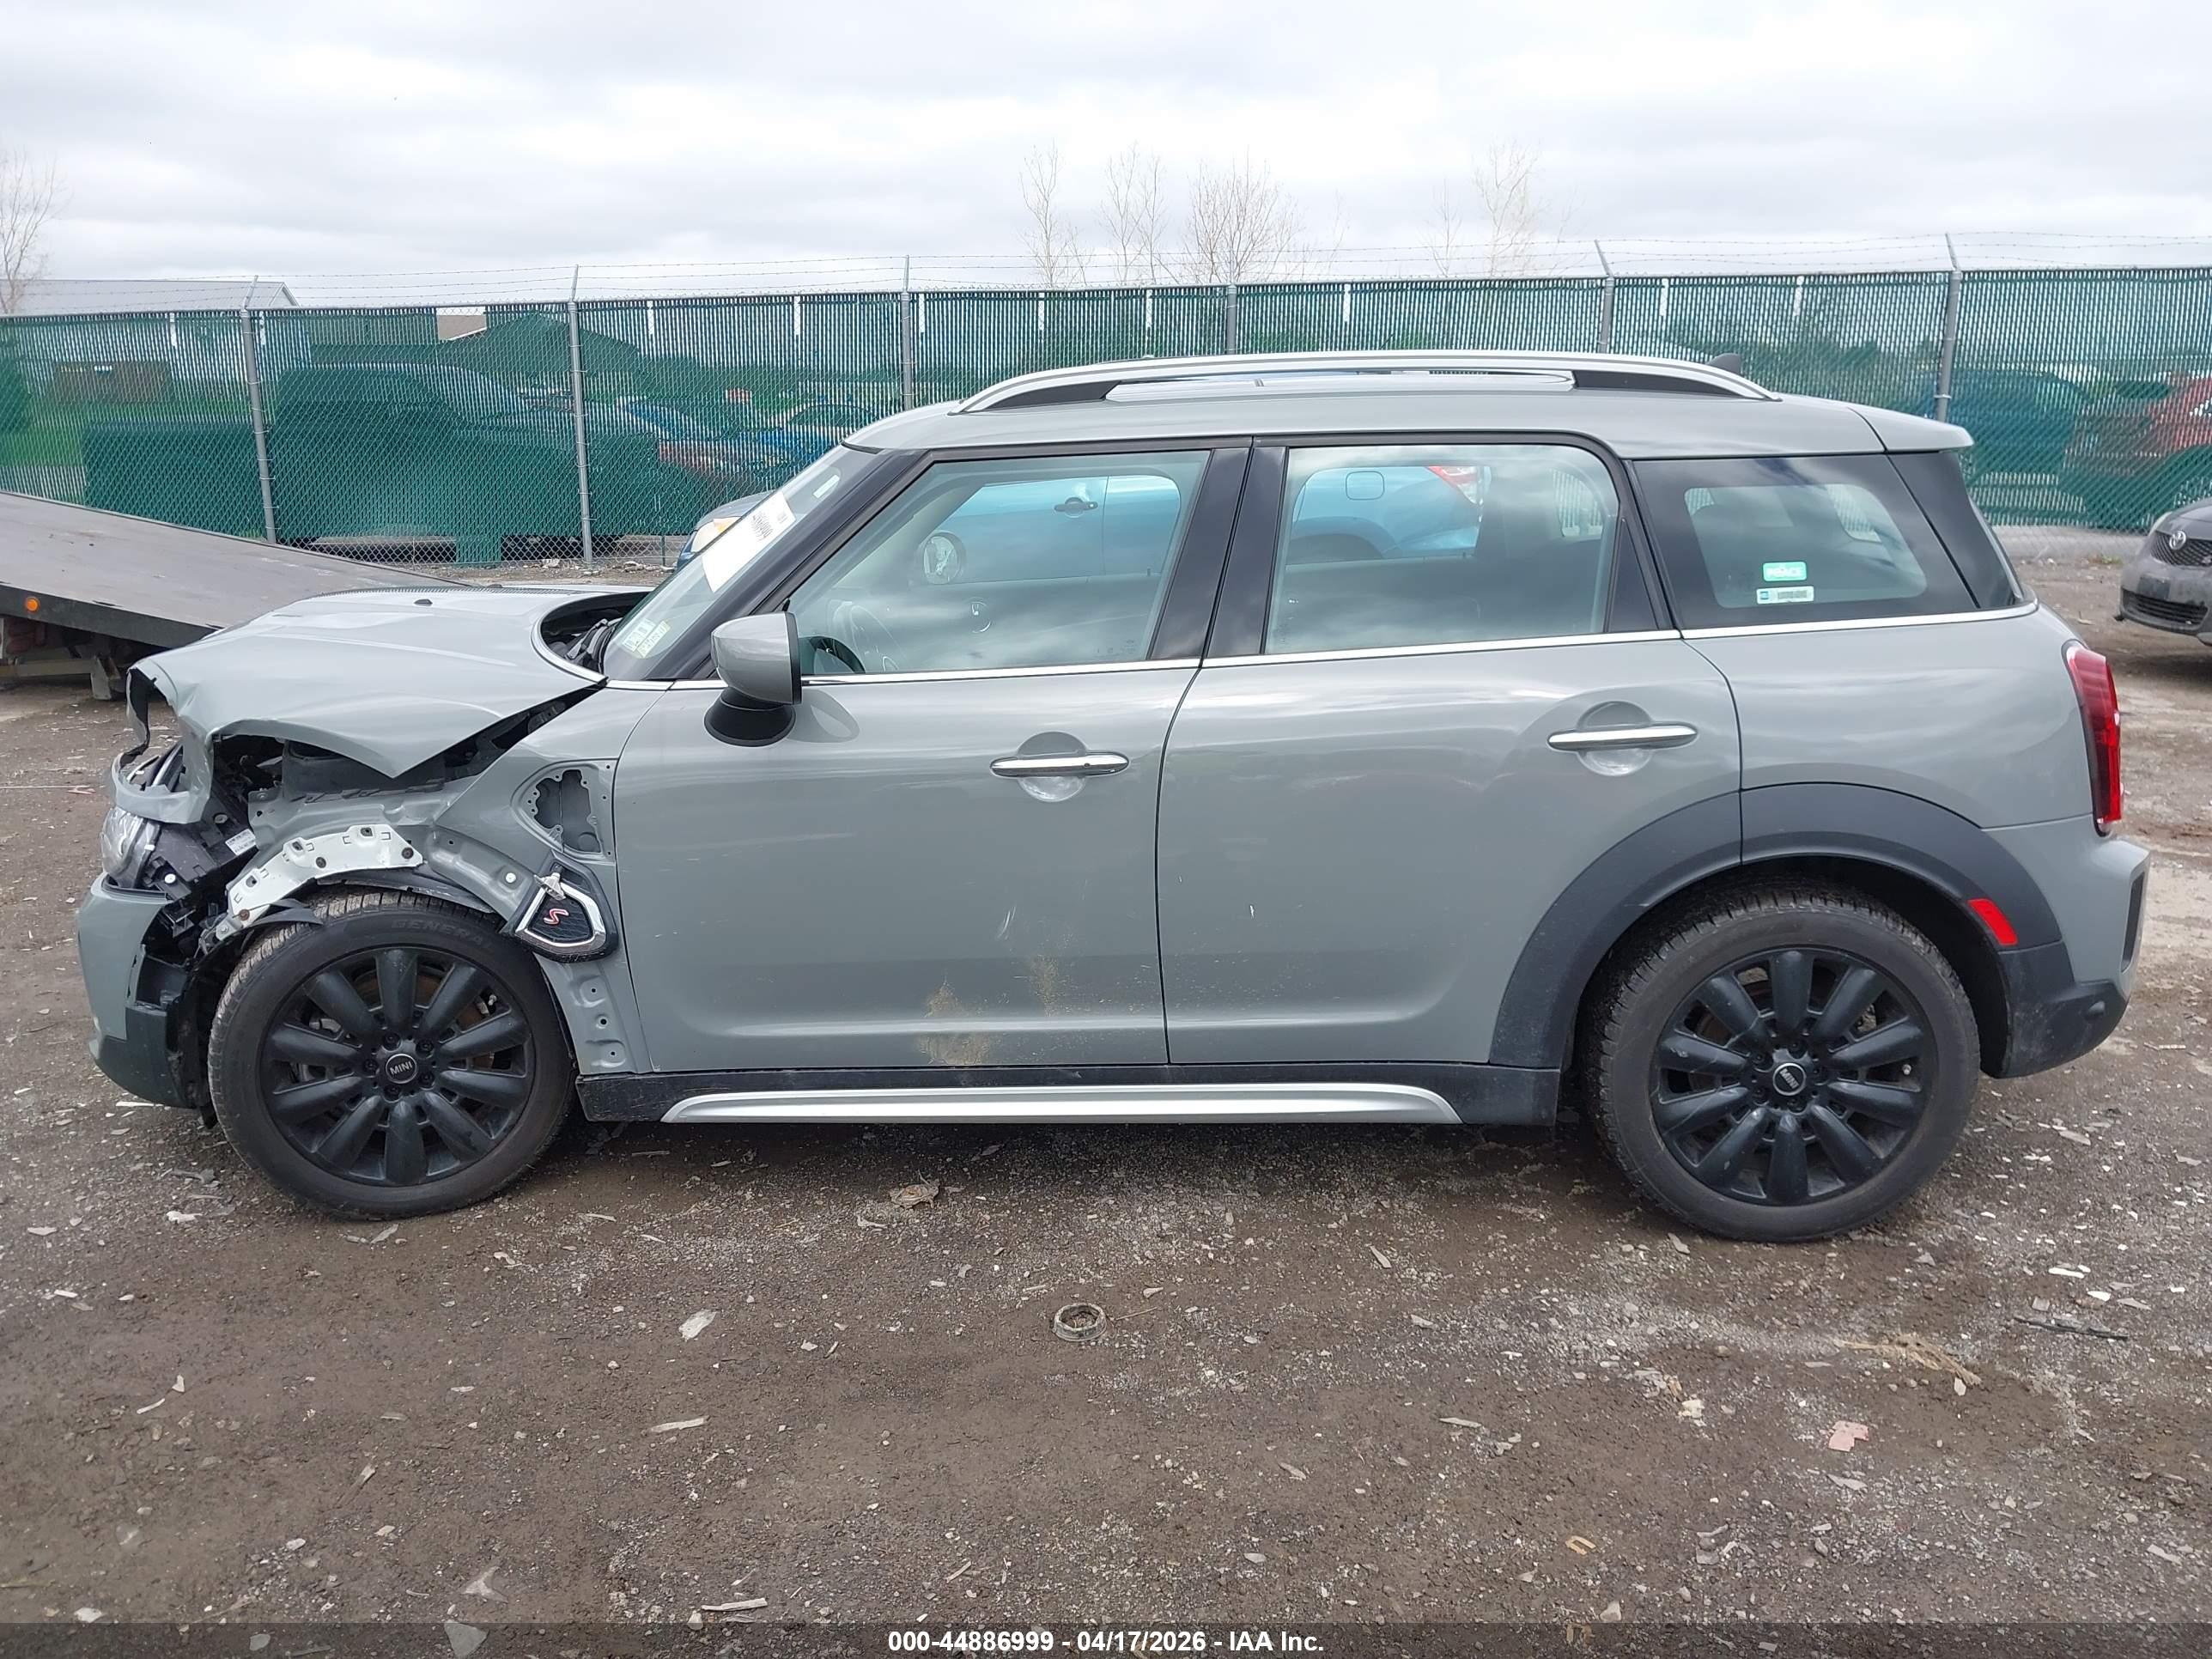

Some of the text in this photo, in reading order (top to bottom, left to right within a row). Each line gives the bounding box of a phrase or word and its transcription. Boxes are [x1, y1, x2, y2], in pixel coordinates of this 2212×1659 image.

[543, 908, 569, 925] S
[389, 1060, 413, 1075] MINI
[1779, 1067, 1800, 1090] MINI
